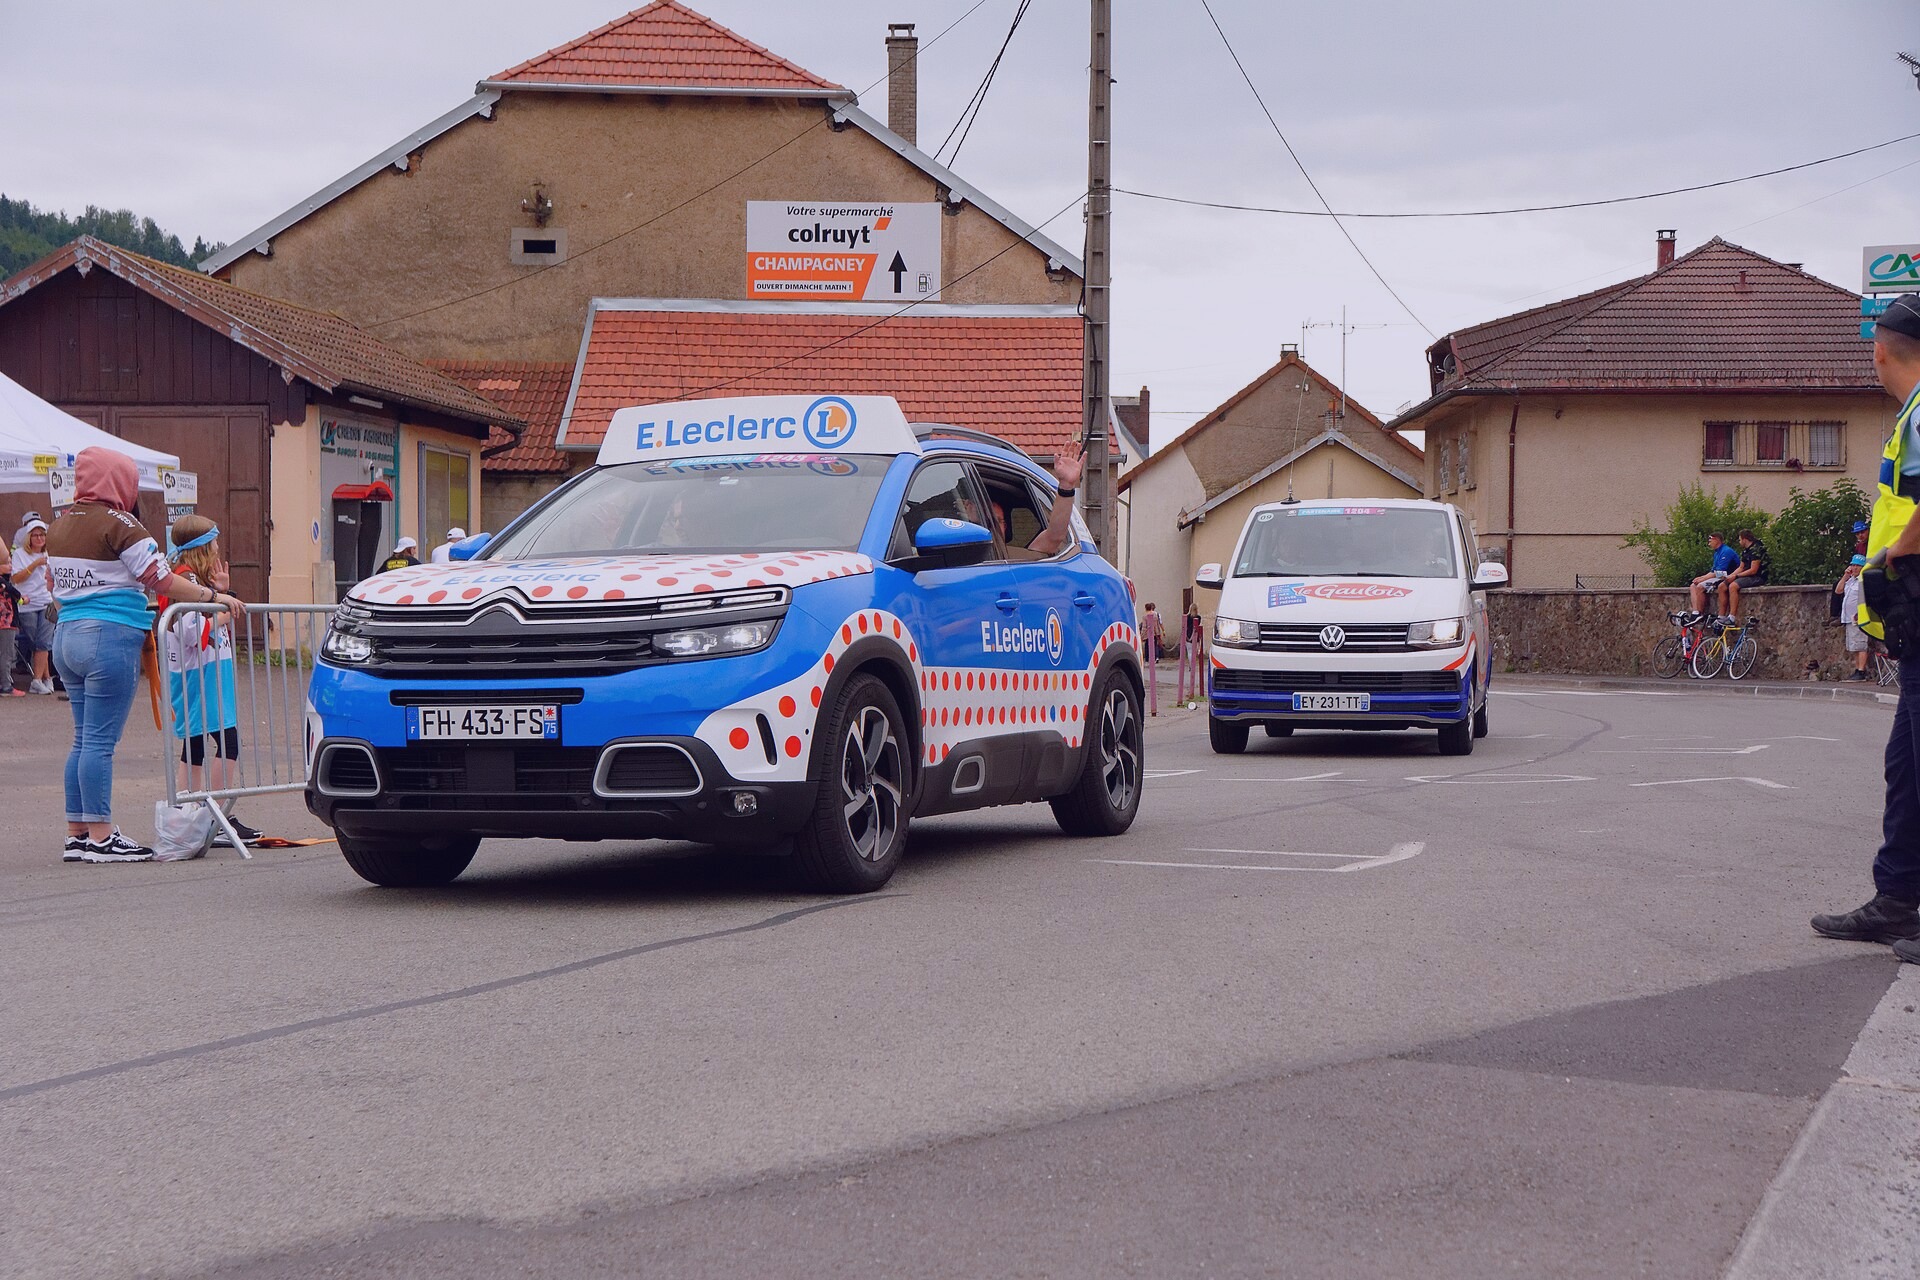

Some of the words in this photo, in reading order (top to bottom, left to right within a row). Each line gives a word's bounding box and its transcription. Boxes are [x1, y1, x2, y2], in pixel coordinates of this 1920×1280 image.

[787, 206, 816, 216] Votre
[819, 207, 894, 218] supermarché
[788, 223, 871, 249] colruyt
[754, 256, 866, 271] CHAMPAGNEY
[785, 283, 823, 291] DIMANCHE
[637, 415, 796, 450] E.Leclerc
[77, 568, 93, 579] LA
[442, 572, 601, 586] E.Leclerc
[1314, 584, 1407, 598] Gaulois
[981, 621, 1045, 653] E.Leclerc
[545, 722, 557, 734] 75
